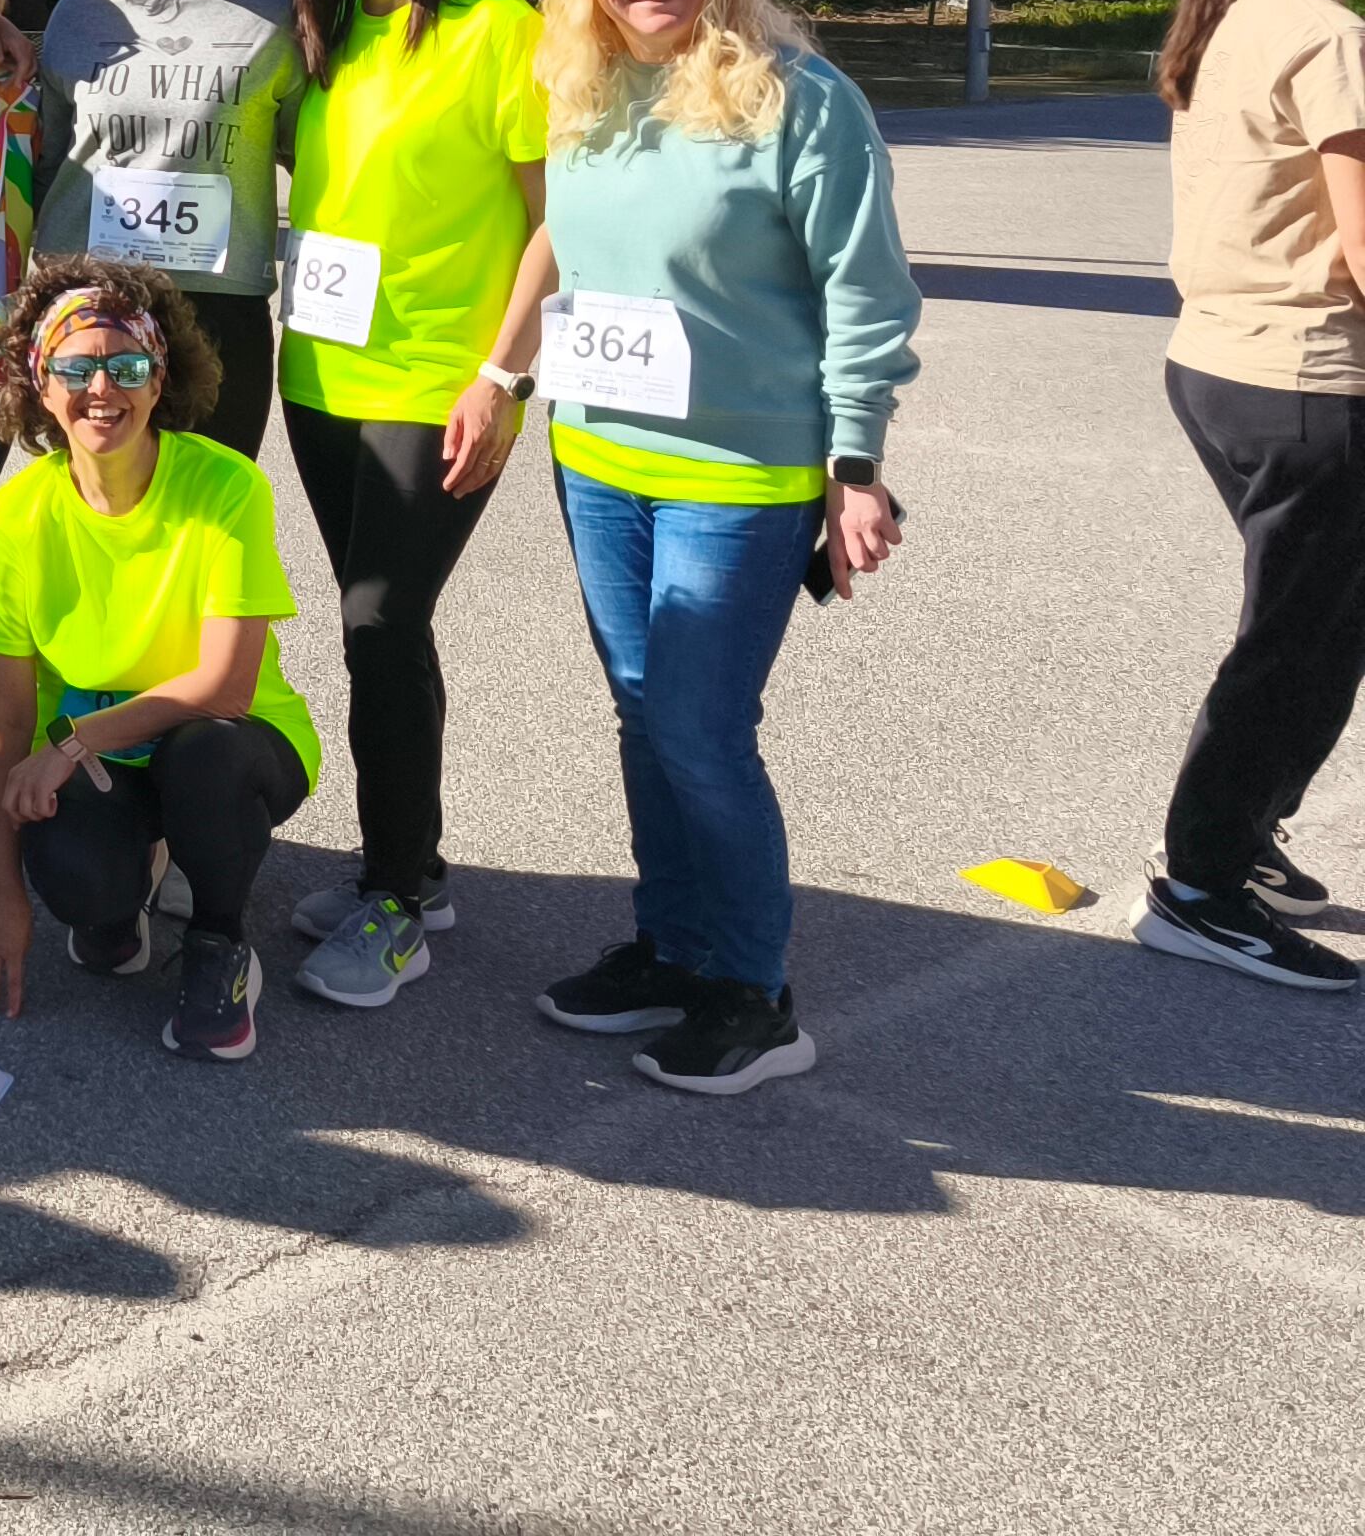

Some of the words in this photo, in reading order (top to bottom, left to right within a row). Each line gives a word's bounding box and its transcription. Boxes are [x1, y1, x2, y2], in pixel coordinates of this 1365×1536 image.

[87, 61, 130, 96] DO
[149, 64, 251, 106] WHAT
[87, 112, 147, 154] YOU
[161, 117, 242, 165] LOVE
[119, 197, 200, 235] 345
[573, 321, 655, 366] 364
